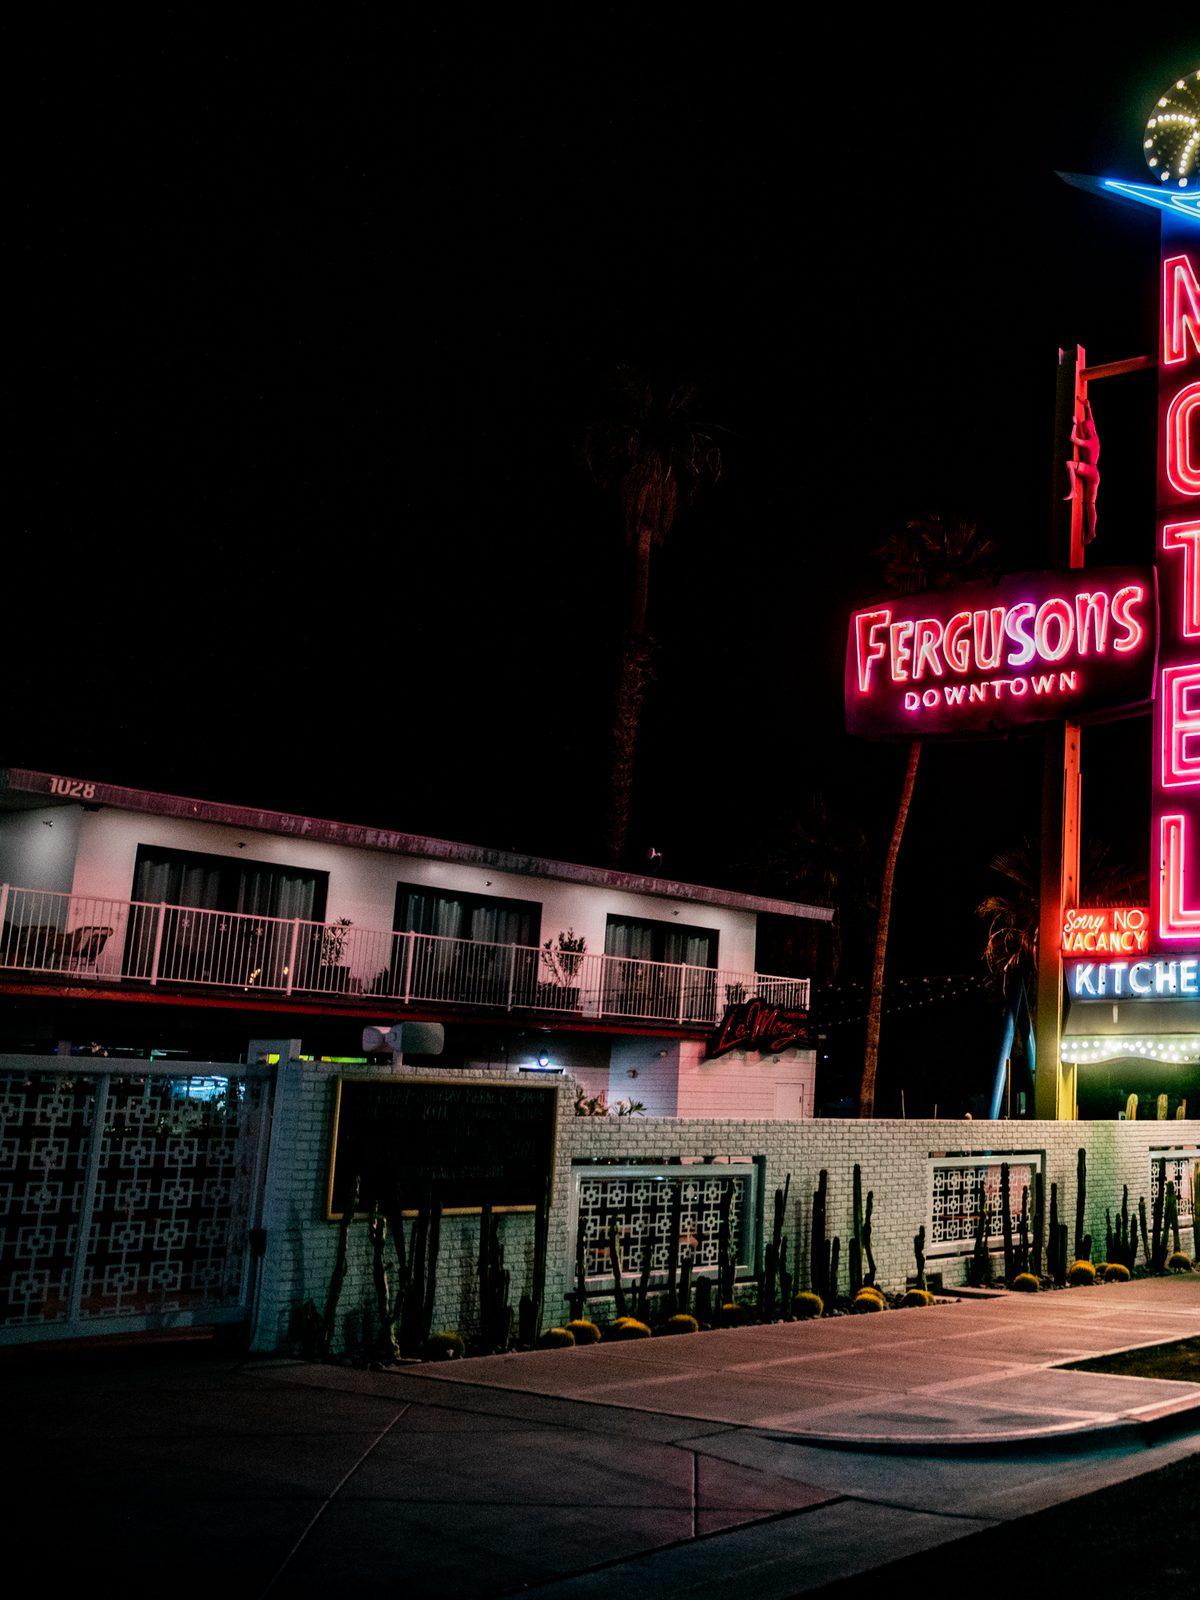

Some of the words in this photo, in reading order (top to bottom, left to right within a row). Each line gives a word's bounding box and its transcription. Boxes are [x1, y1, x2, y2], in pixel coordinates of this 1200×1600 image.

[904, 671, 1077, 711] DOWNTOWN
[50, 777, 95, 799] 1028
[1063, 909, 1105, 934] Sorry
[1113, 909, 1145, 931] NO
[1062, 930, 1146, 952] VACANCY
